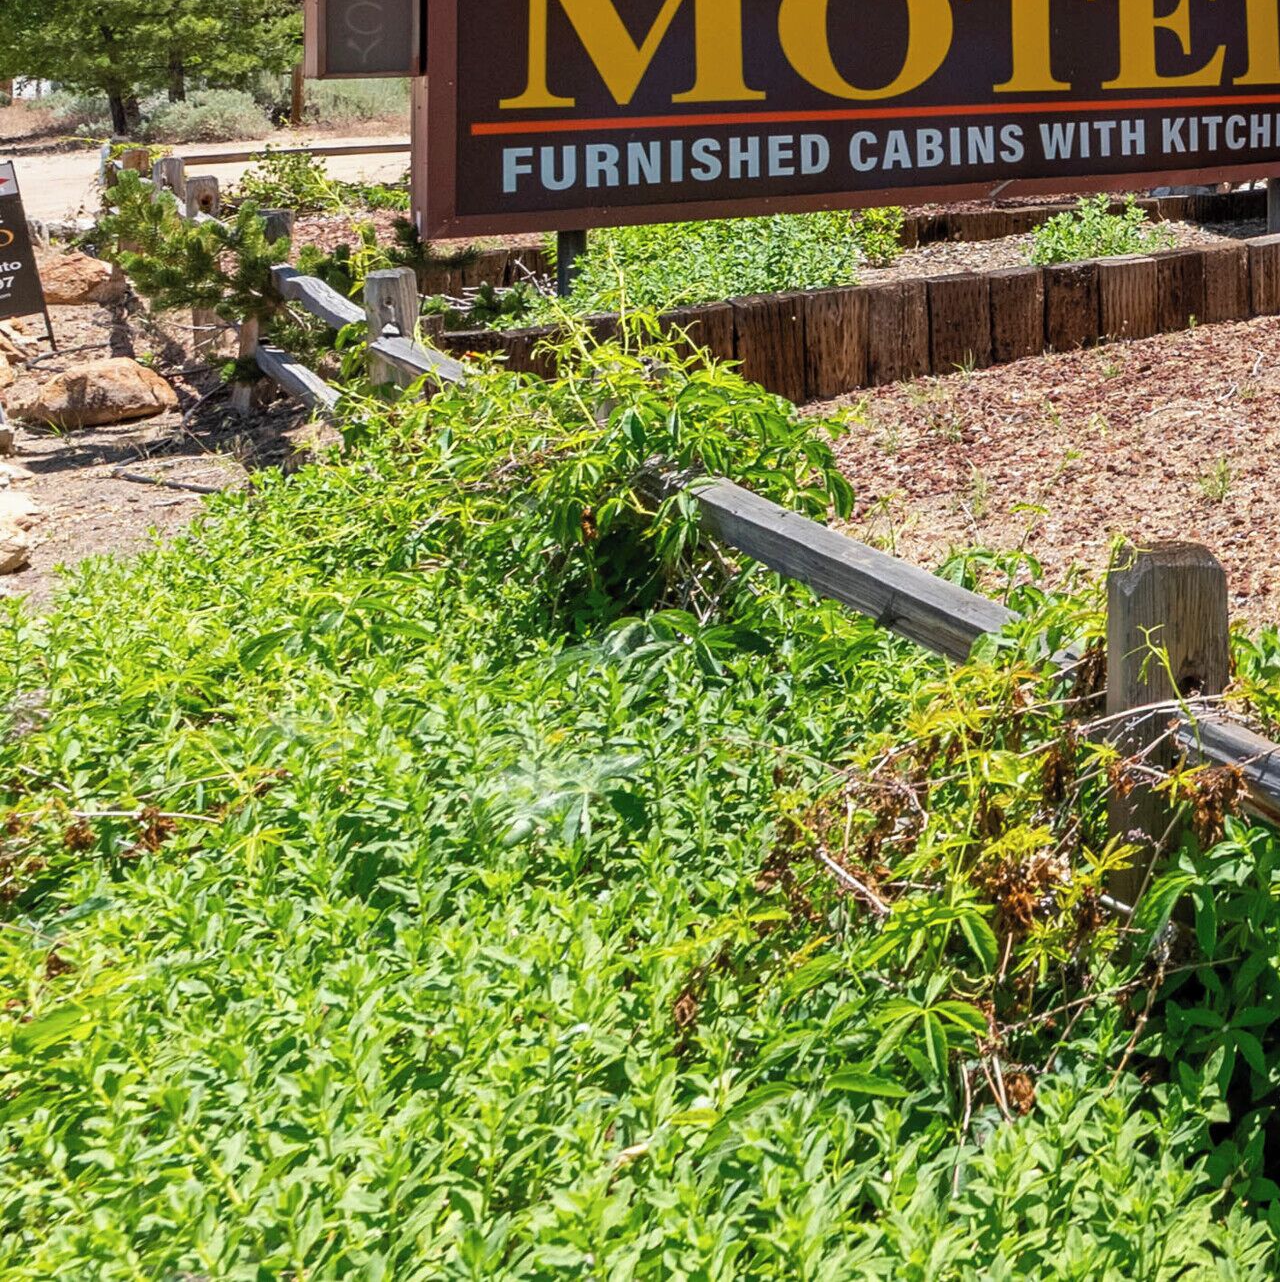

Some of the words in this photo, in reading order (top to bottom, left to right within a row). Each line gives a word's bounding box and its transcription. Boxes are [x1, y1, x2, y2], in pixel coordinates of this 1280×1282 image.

[502, 133, 830, 193] FURNISHED
[849, 124, 1025, 172] CABINS
[1039, 117, 1146, 160] WITH
